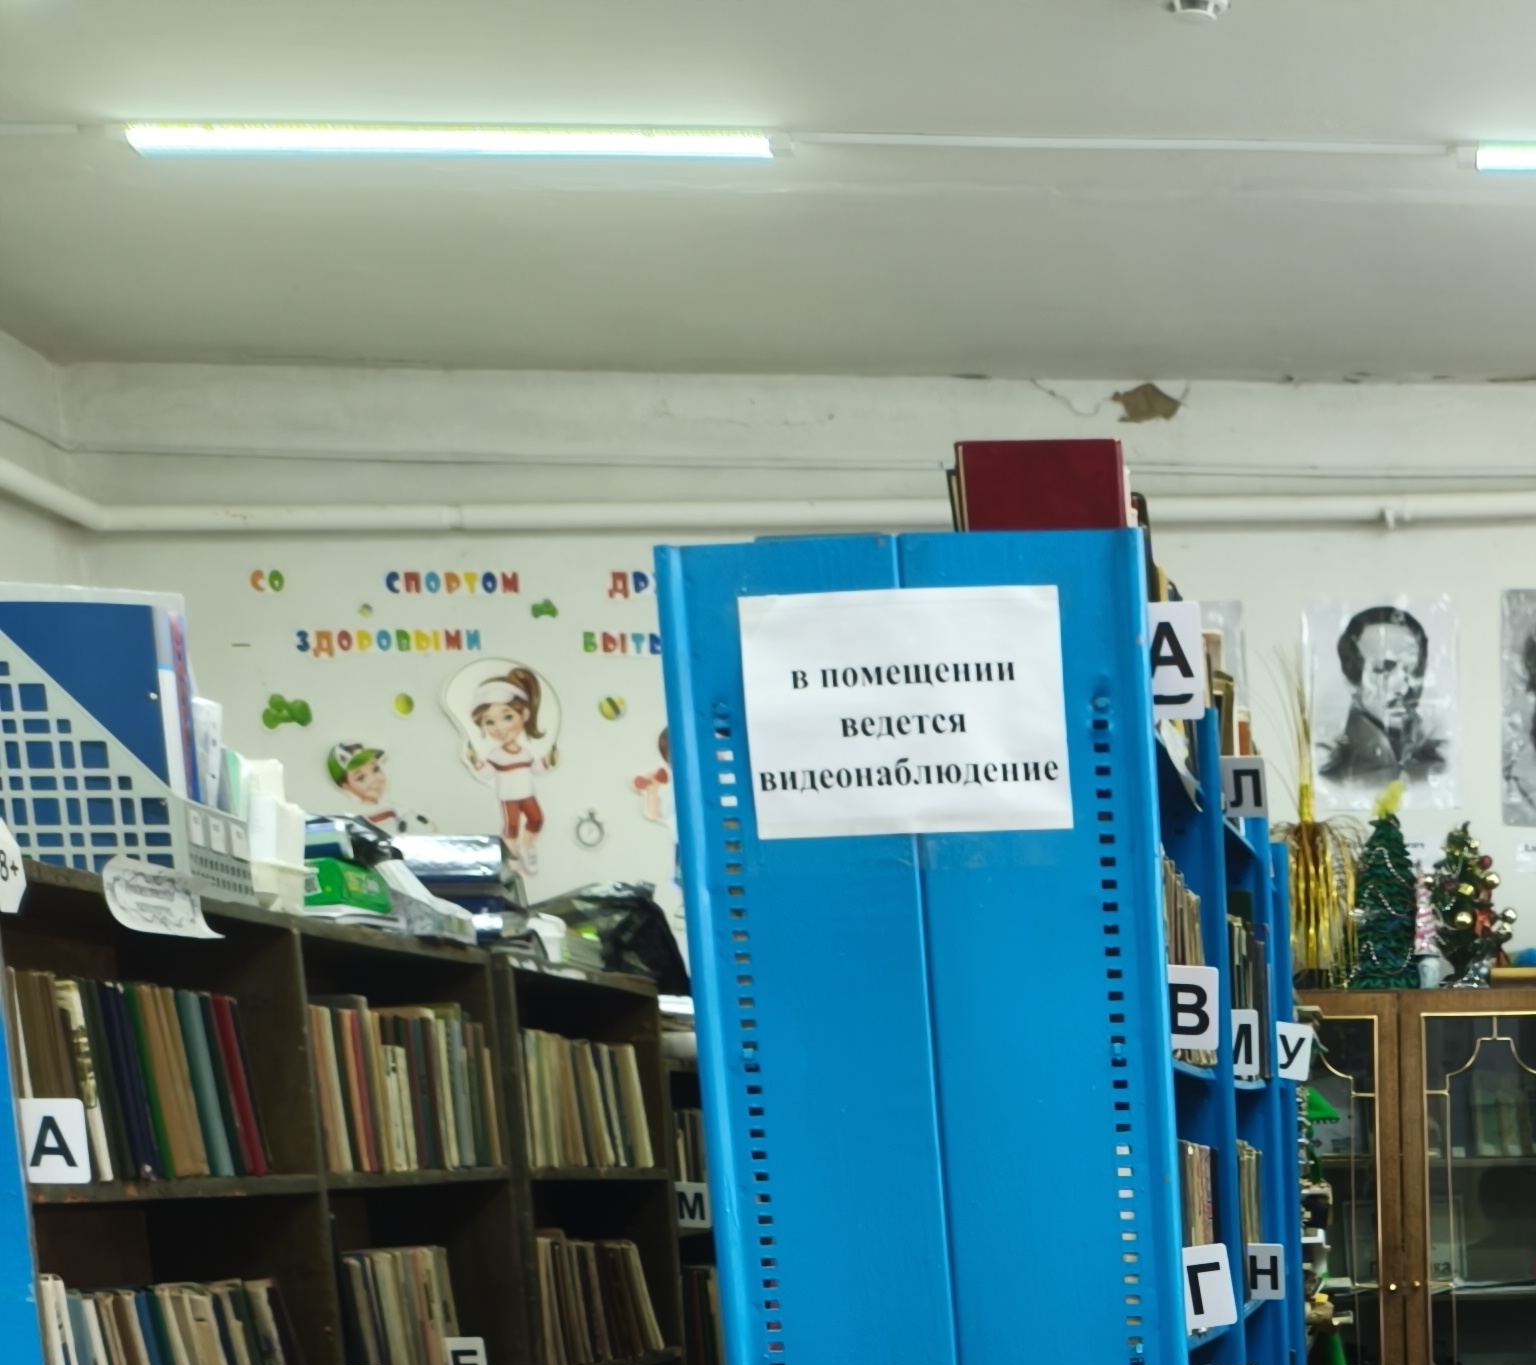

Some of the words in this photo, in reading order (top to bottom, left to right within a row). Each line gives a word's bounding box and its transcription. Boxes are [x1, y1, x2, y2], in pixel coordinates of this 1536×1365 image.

[249, 569, 285, 594] СО
[385, 570, 521, 595] СПОРТОМ
[608, 570, 656, 600] ДР
[295, 628, 482, 659] ЗДОРОВЫМИ
[582, 631, 662, 656] БЫТЬ
[1150, 620, 1195, 679] А
[820, 660, 1016, 690] помещении
[839, 712, 967, 740] ведется
[758, 756, 1060, 793] видеонаблюдение
[1229, 768, 1263, 808] Л
[1170, 983, 1210, 1036] В
[1278, 1033, 1306, 1070] У
[30, 1116, 77, 1168] А
[677, 1191, 706, 1221] М
[1186, 1261, 1222, 1316] Г
[1250, 1255, 1280, 1290] Н
